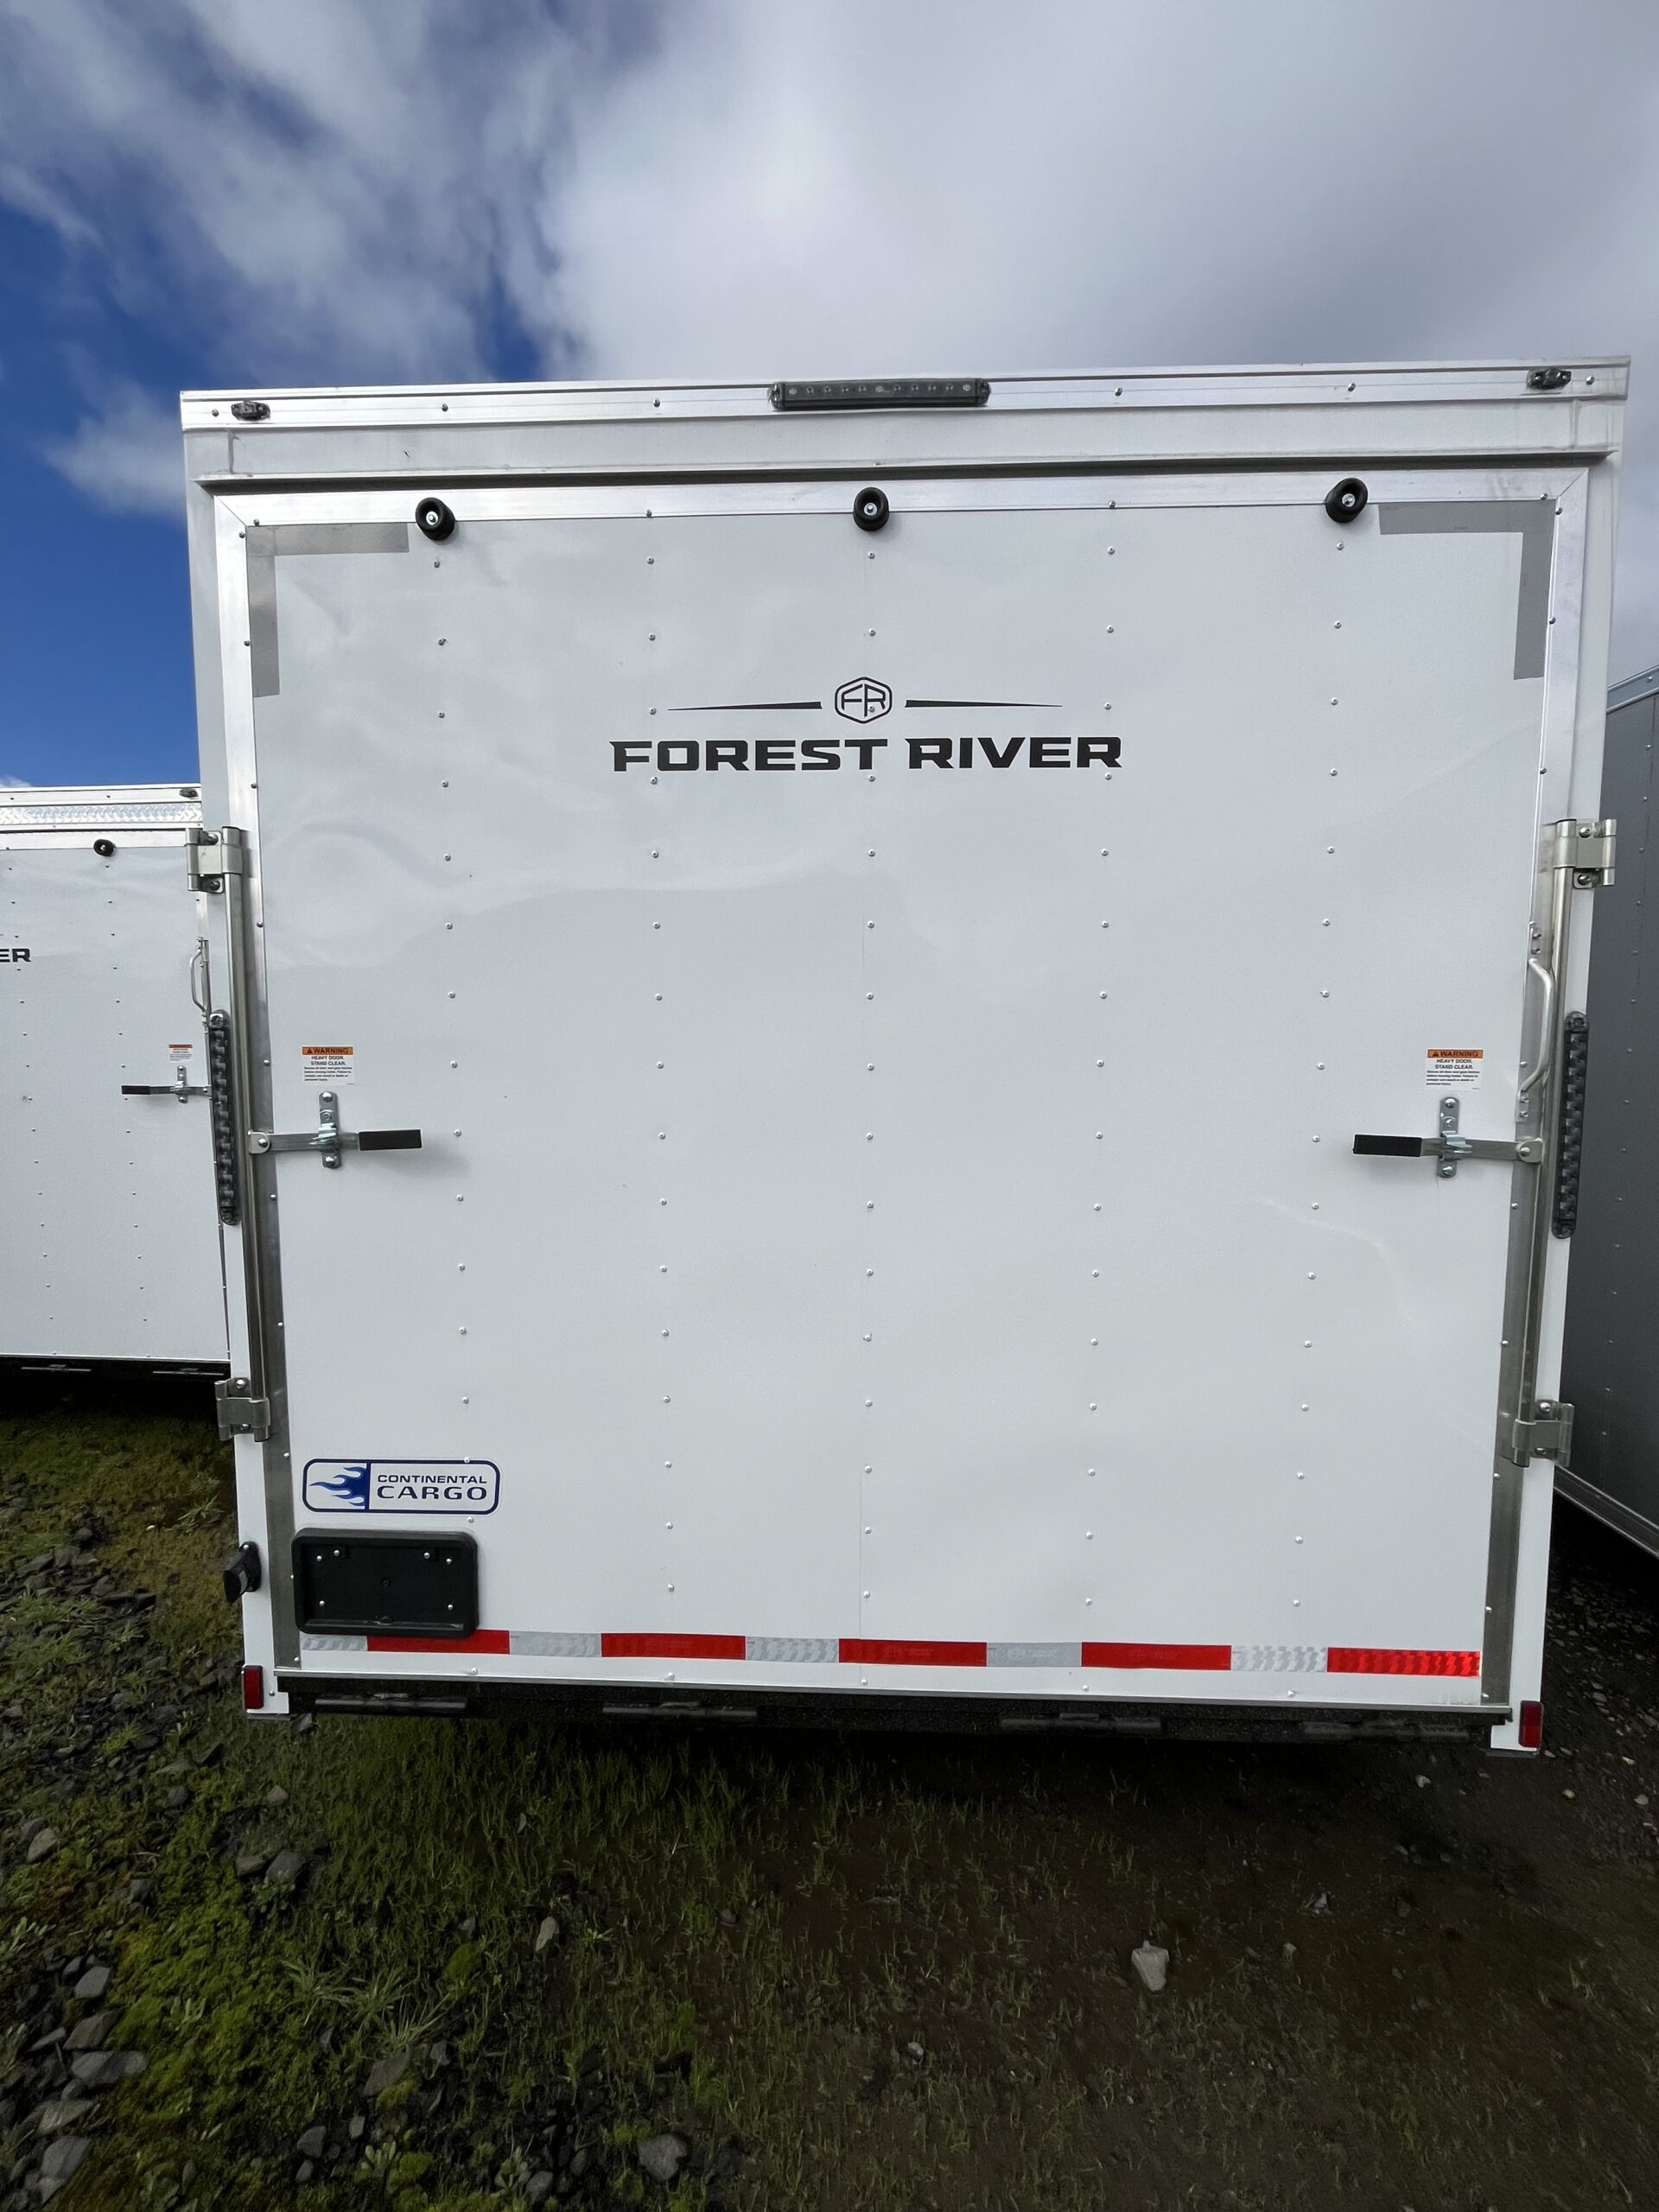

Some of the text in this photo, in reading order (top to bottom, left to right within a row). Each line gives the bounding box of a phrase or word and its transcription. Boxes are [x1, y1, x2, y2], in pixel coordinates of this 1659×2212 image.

[608, 736, 1122, 772] FOREST RIVER
[378, 1474, 488, 1484] CONTINENTAL
[377, 1485, 488, 1500] CARGO
